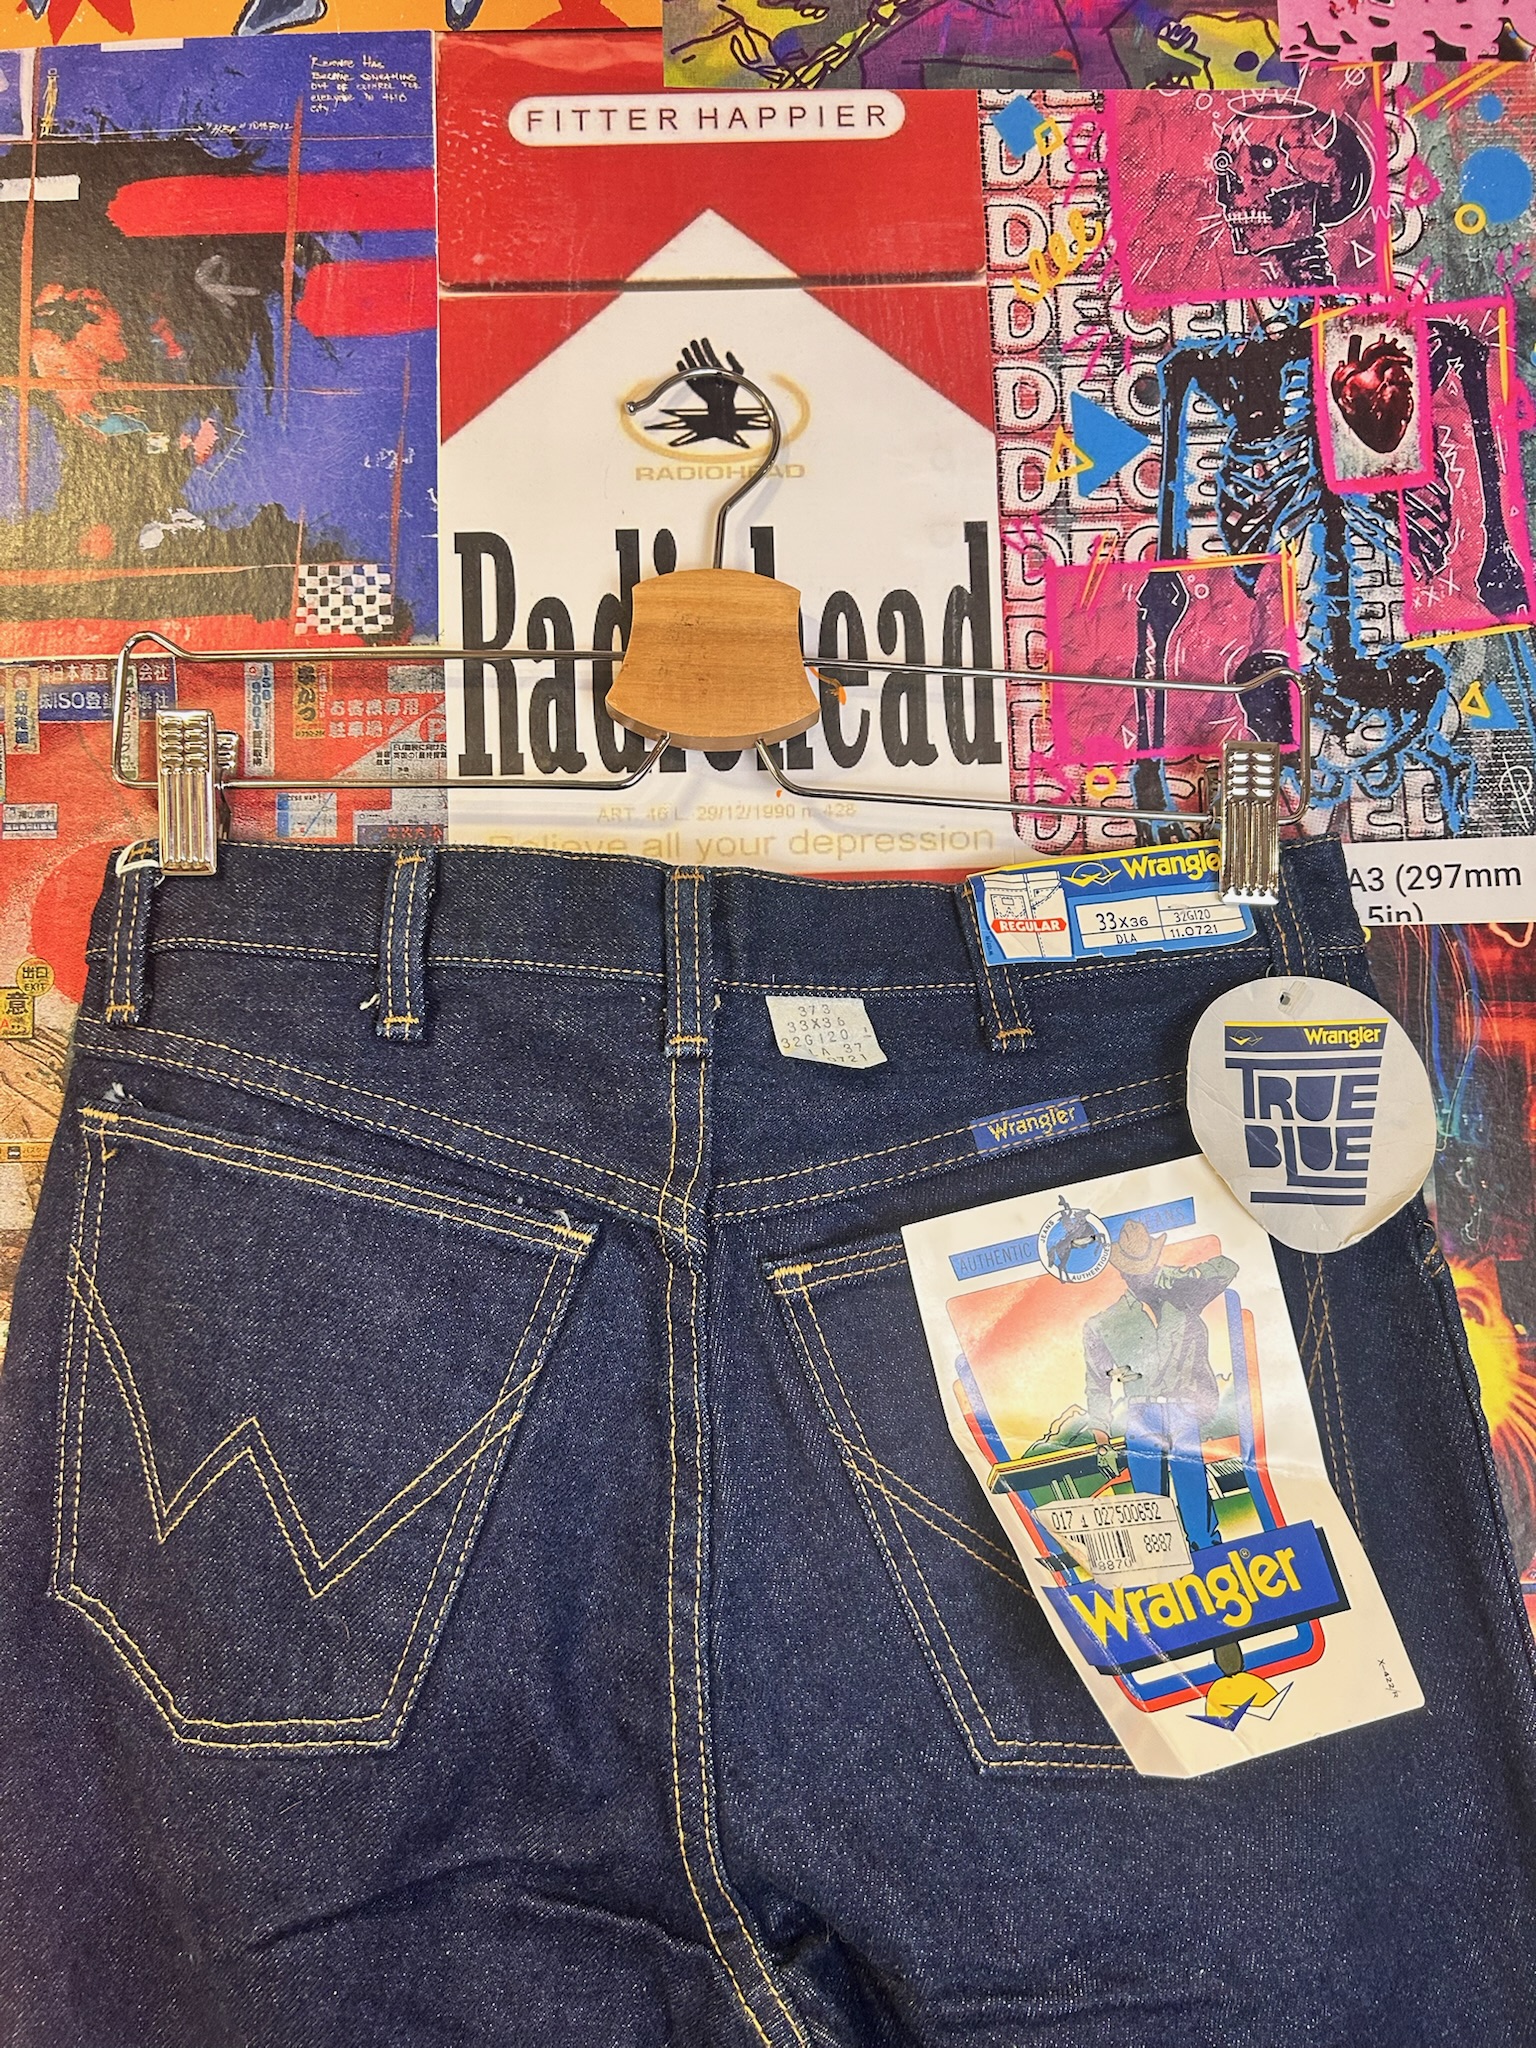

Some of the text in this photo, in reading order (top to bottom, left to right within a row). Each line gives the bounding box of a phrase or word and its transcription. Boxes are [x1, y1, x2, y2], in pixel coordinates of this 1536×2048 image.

[526, 104, 887, 133] FITTER HAPPIER
[642, 829, 681, 859] all
[694, 837, 777, 869] your
[787, 825, 994, 866] depression
[1121, 848, 1220, 881] Wrangle
[1396, 863, 1522, 898] (297mm
[999, 919, 1062, 934] REGULAR
[1116, 934, 1138, 945] DLA
[1169, 924, 1219, 939] 11.0721
[1303, 1026, 1382, 1049] Wrangler
[1225, 1055, 1383, 1122] TRUE
[986, 1106, 1076, 1142] Wrangler
[1243, 1123, 1374, 1189] BLUE
[1039, 1219, 1055, 1244] JEANS
[959, 1241, 1033, 1275] AUTHENTIC
[1051, 1510, 1074, 1531] 017
[1143, 1532, 1173, 1554] 8887
[1070, 1546, 1303, 1647] Wrangler
